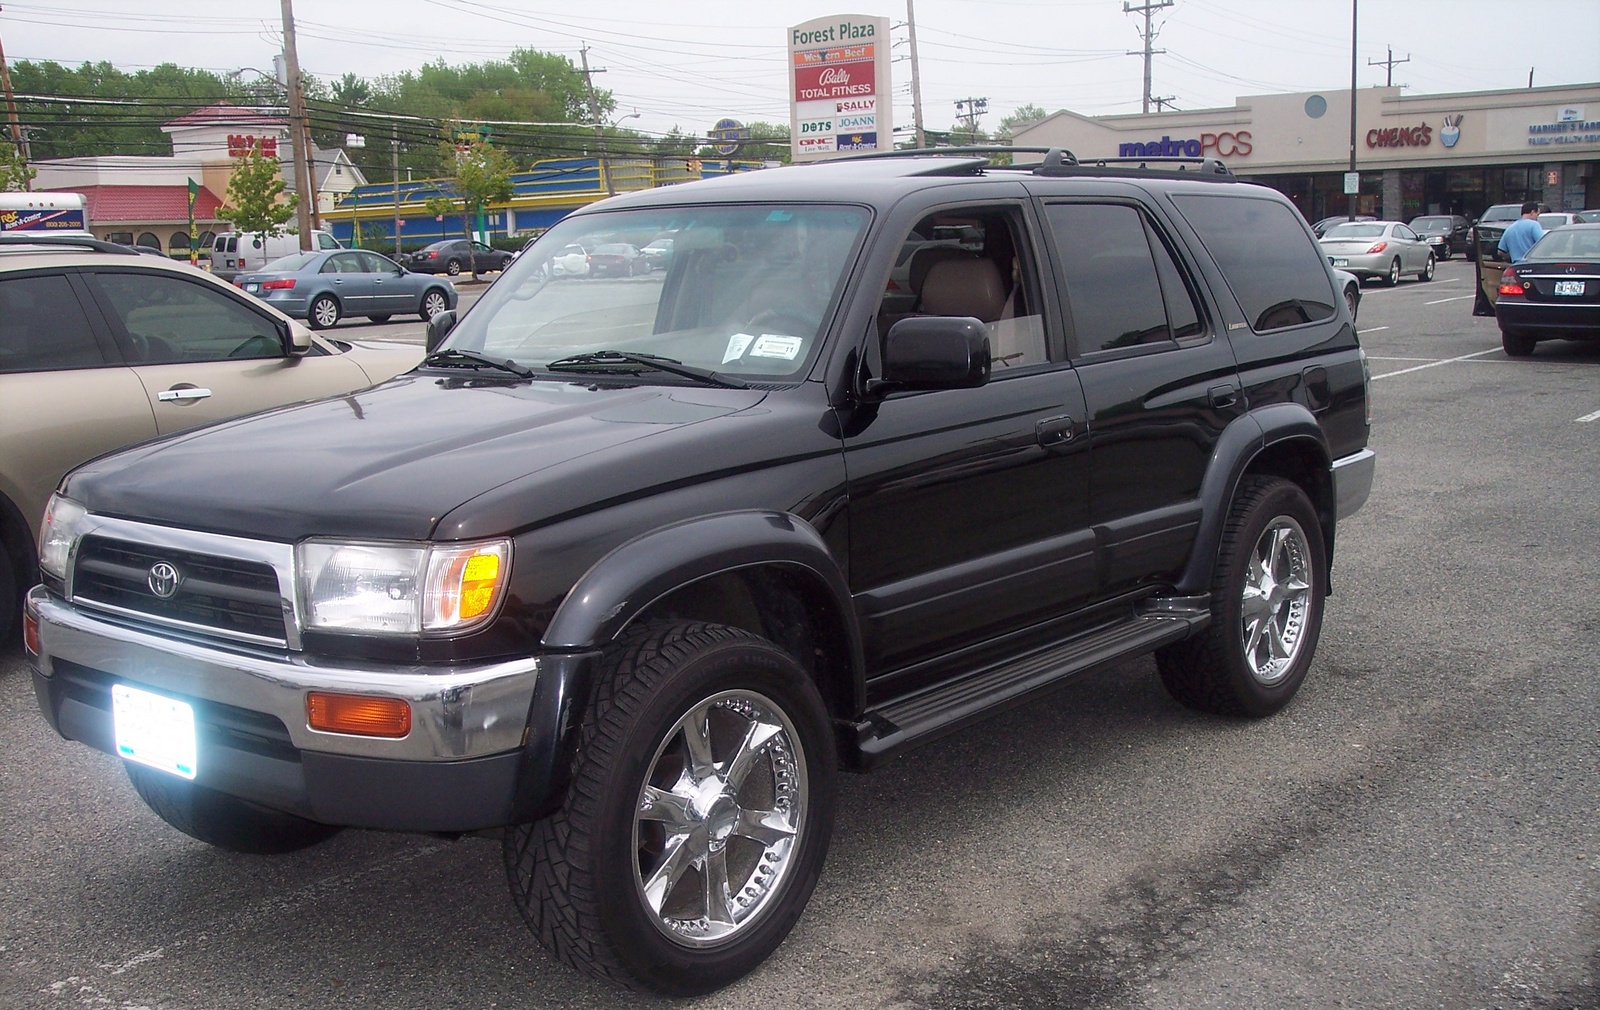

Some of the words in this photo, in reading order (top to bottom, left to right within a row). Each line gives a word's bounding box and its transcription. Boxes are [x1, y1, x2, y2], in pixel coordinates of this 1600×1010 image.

[793, 26, 835, 45] Forest
[840, 22, 875, 40] Plaza
[844, 47, 866, 58] Beef
[819, 68, 850, 86] Bally
[800, 88, 830, 99] TOTAL
[832, 84, 871, 96] FITNESS
[843, 100, 875, 110] SALLY
[802, 121, 832, 133] DOTS
[799, 137, 834, 146] GNC
[1366, 121, 1433, 149] CHENG'S
[1119, 131, 1253, 157] metroPCS
[0, 211, 19, 224] RAC
